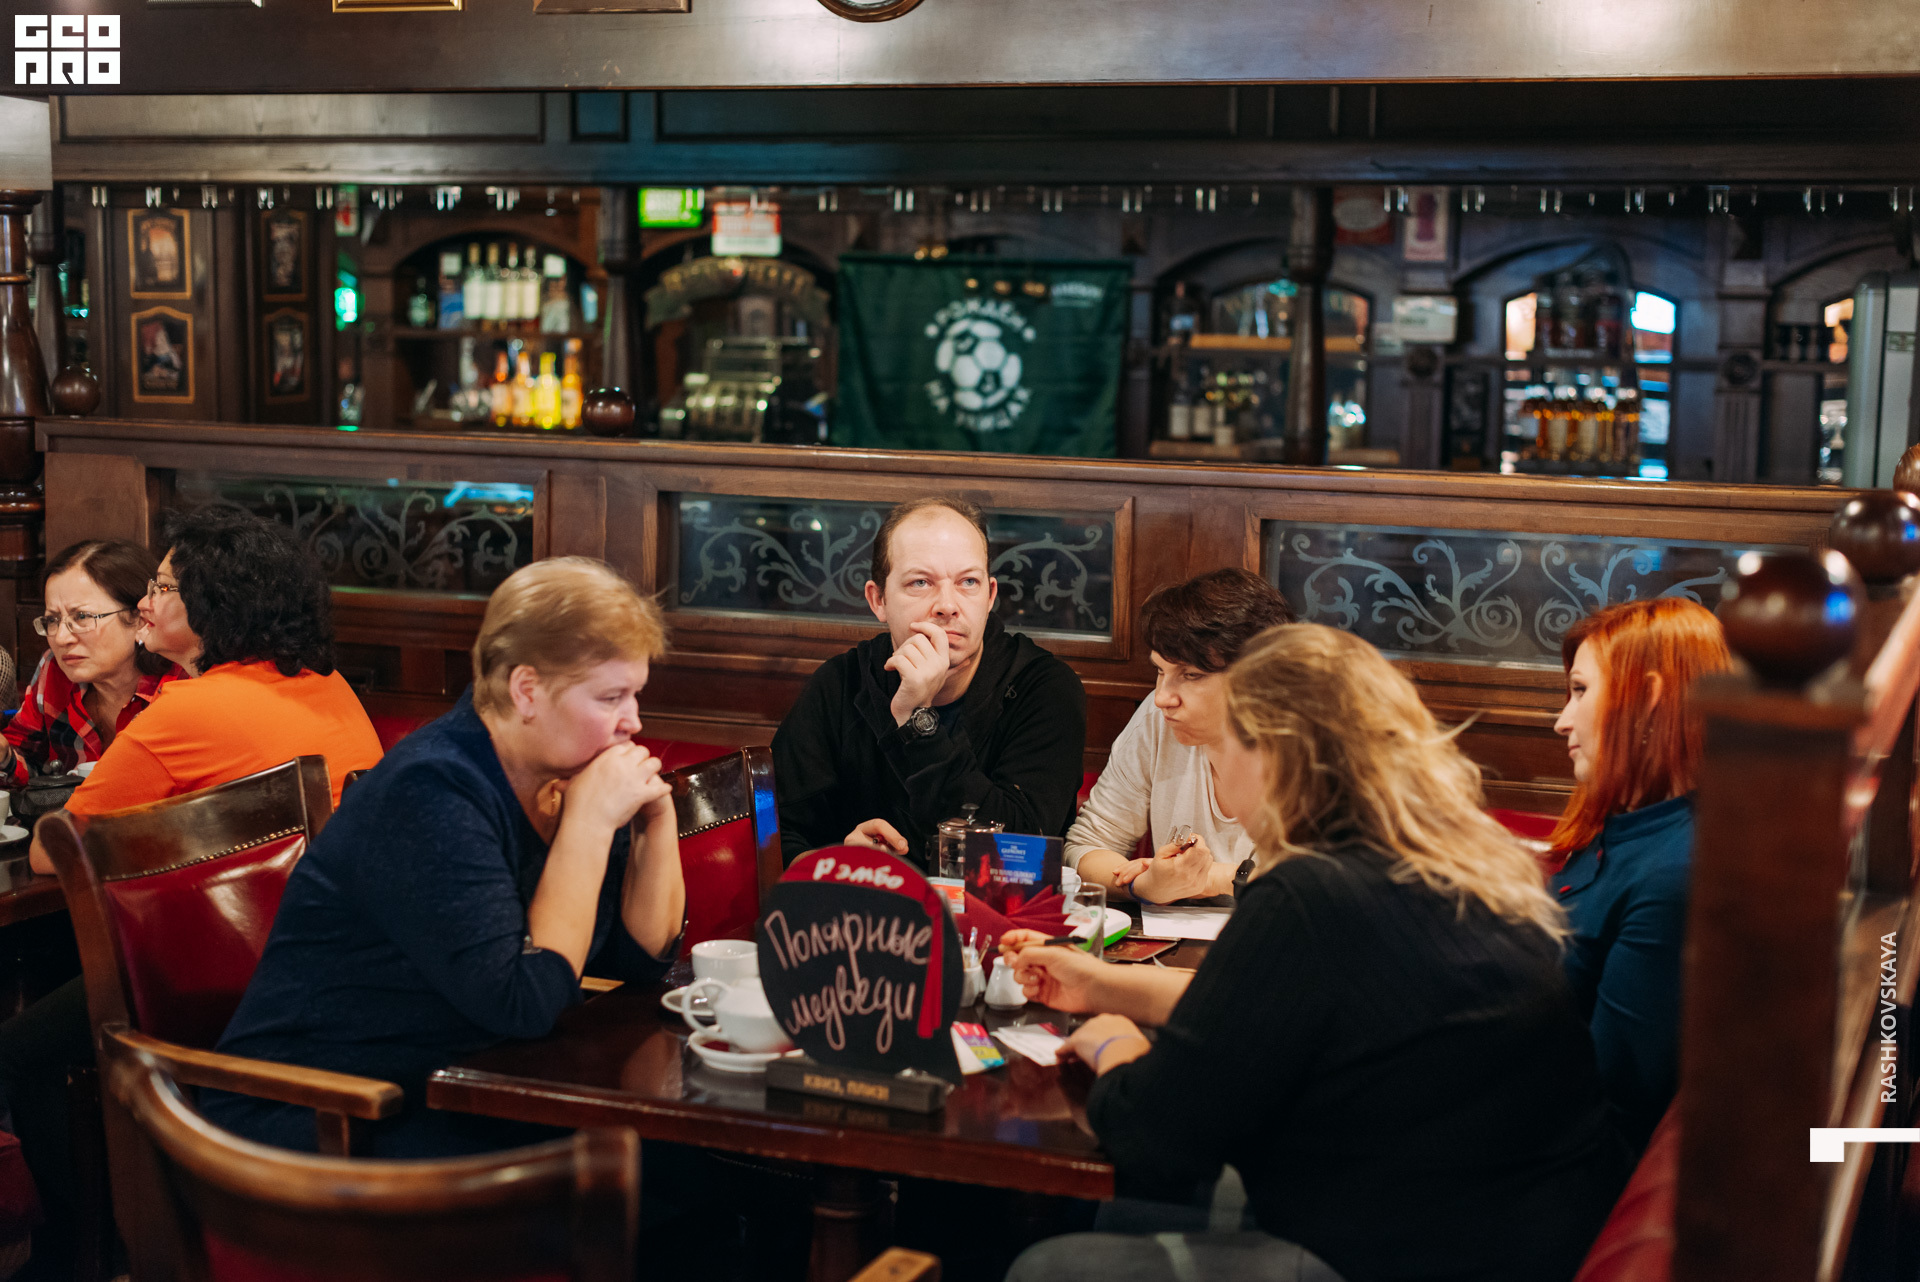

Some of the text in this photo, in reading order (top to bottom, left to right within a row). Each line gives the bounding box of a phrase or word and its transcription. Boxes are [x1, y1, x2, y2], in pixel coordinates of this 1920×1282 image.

[813, 858, 904, 889] Рэмбо
[764, 909, 932, 982] Полярные
[785, 964, 916, 1054] медведи
